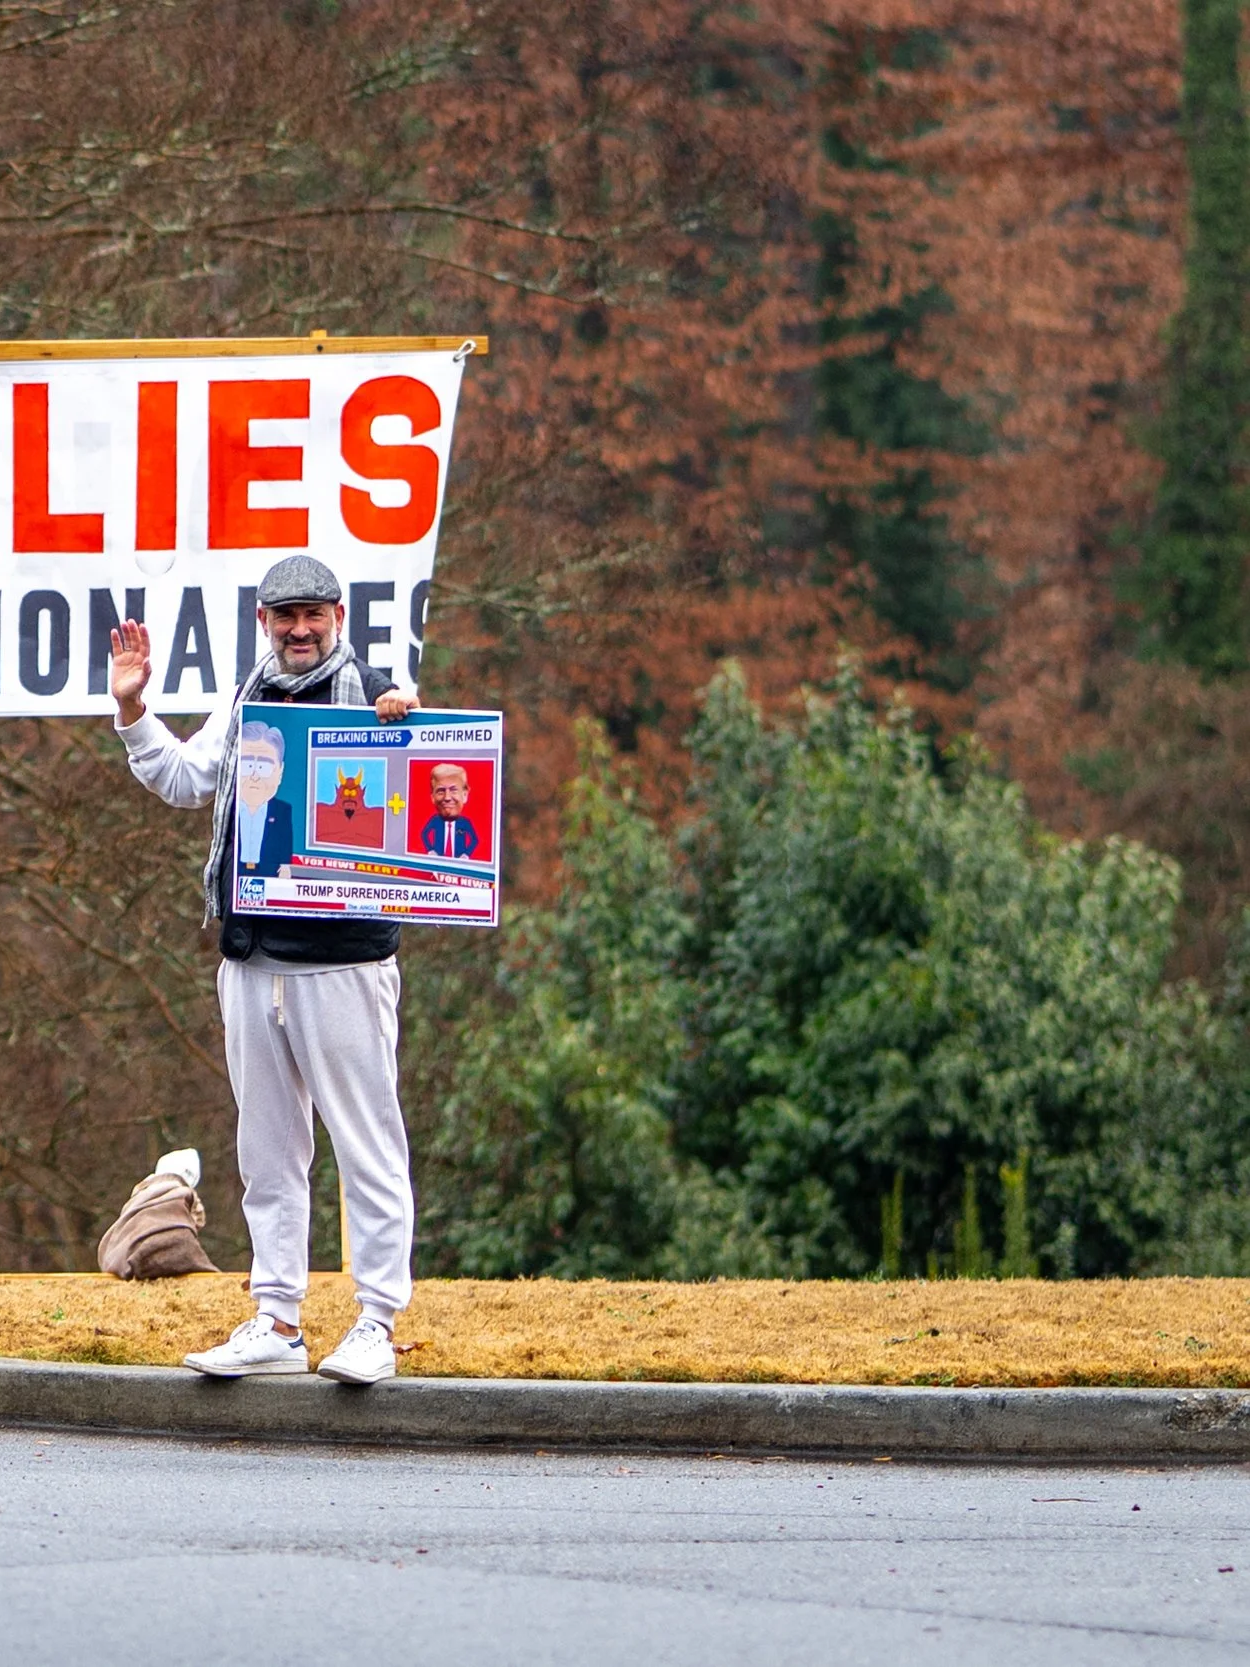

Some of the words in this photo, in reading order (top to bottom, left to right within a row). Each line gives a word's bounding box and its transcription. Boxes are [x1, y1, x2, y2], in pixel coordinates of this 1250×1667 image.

[317, 731, 368, 744] BREAKING
[370, 731, 402, 744] NEWS
[420, 729, 492, 742] CONFIRMED
[304, 857, 323, 867] FOX
[325, 859, 356, 870] NEWS
[356, 863, 400, 876] ALERT
[439, 873, 459, 885] FOX
[460, 877, 490, 889] NEWS
[247, 884, 264, 893] FOX
[296, 885, 334, 897] TRUMP
[336, 886, 409, 901] SURRENDERS
[411, 891, 460, 903] AMERICA
[383, 905, 411, 913] ALERT
